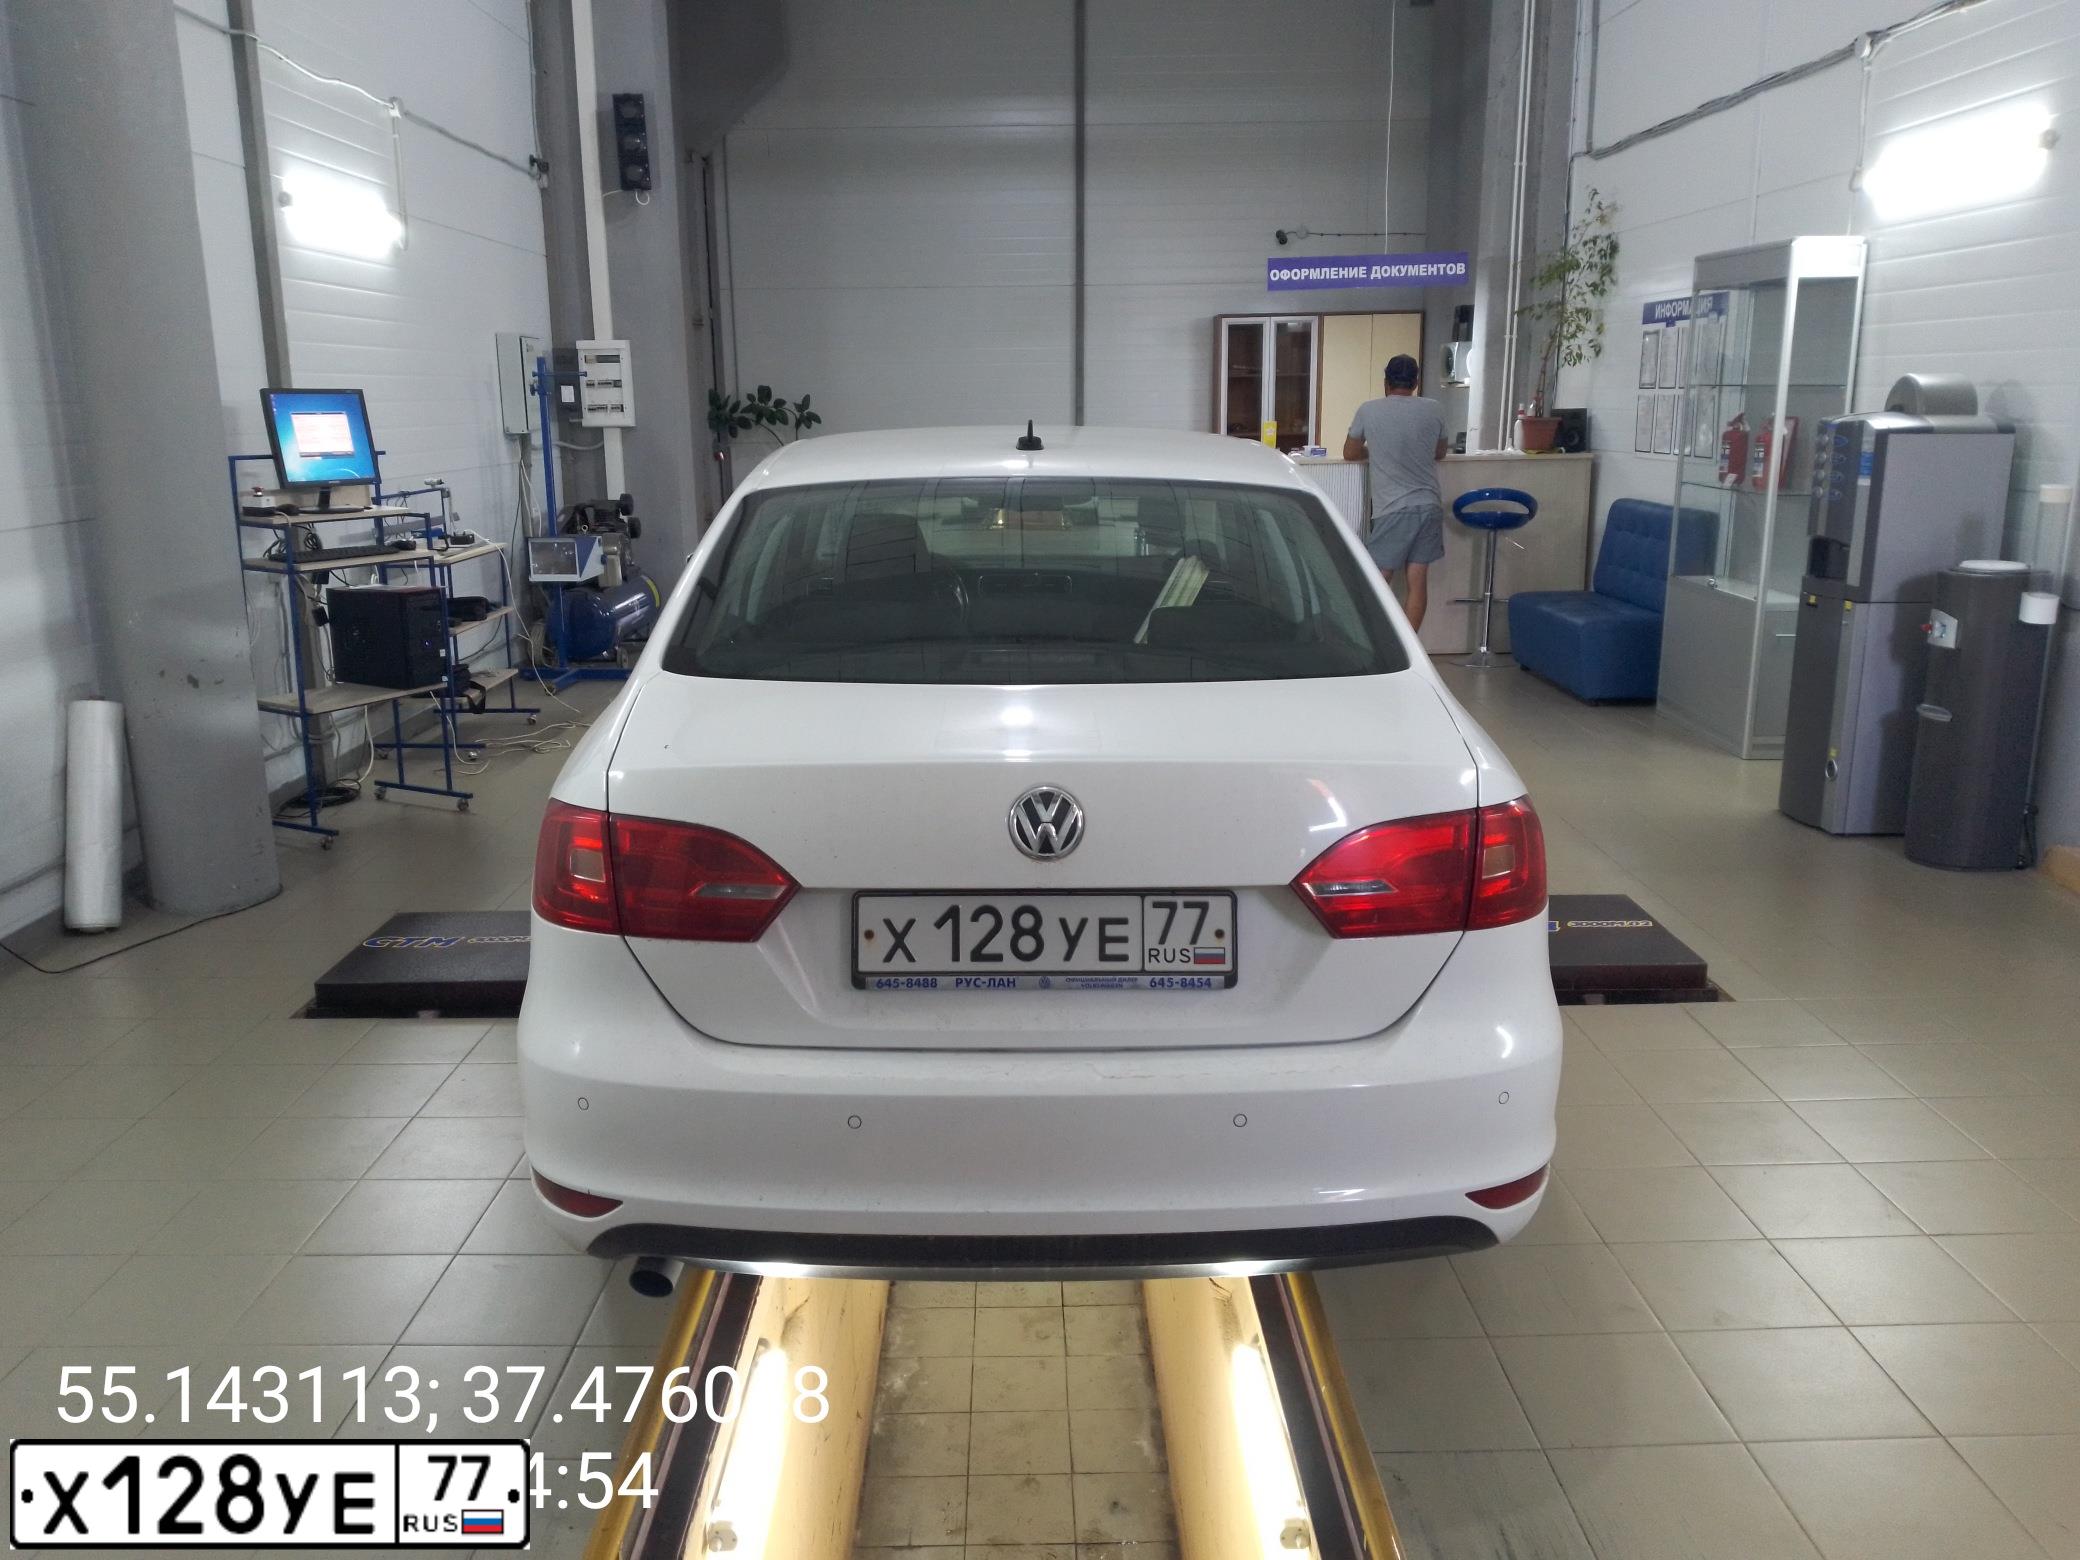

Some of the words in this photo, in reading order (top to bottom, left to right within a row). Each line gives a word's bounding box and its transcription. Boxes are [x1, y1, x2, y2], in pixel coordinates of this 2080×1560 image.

[1269, 266, 1367, 281] ОФОРМЛЕНИЕ
[1370, 262, 1466, 279] ДОКУМЕНТОВ
[1151, 900, 1210, 946] 77
[1147, 946, 1191, 964] RUS
[875, 977, 938, 988] 645-8488
[955, 977, 1016, 988] РУС-ЛАН
[1149, 977, 1212, 988] 645-8454
